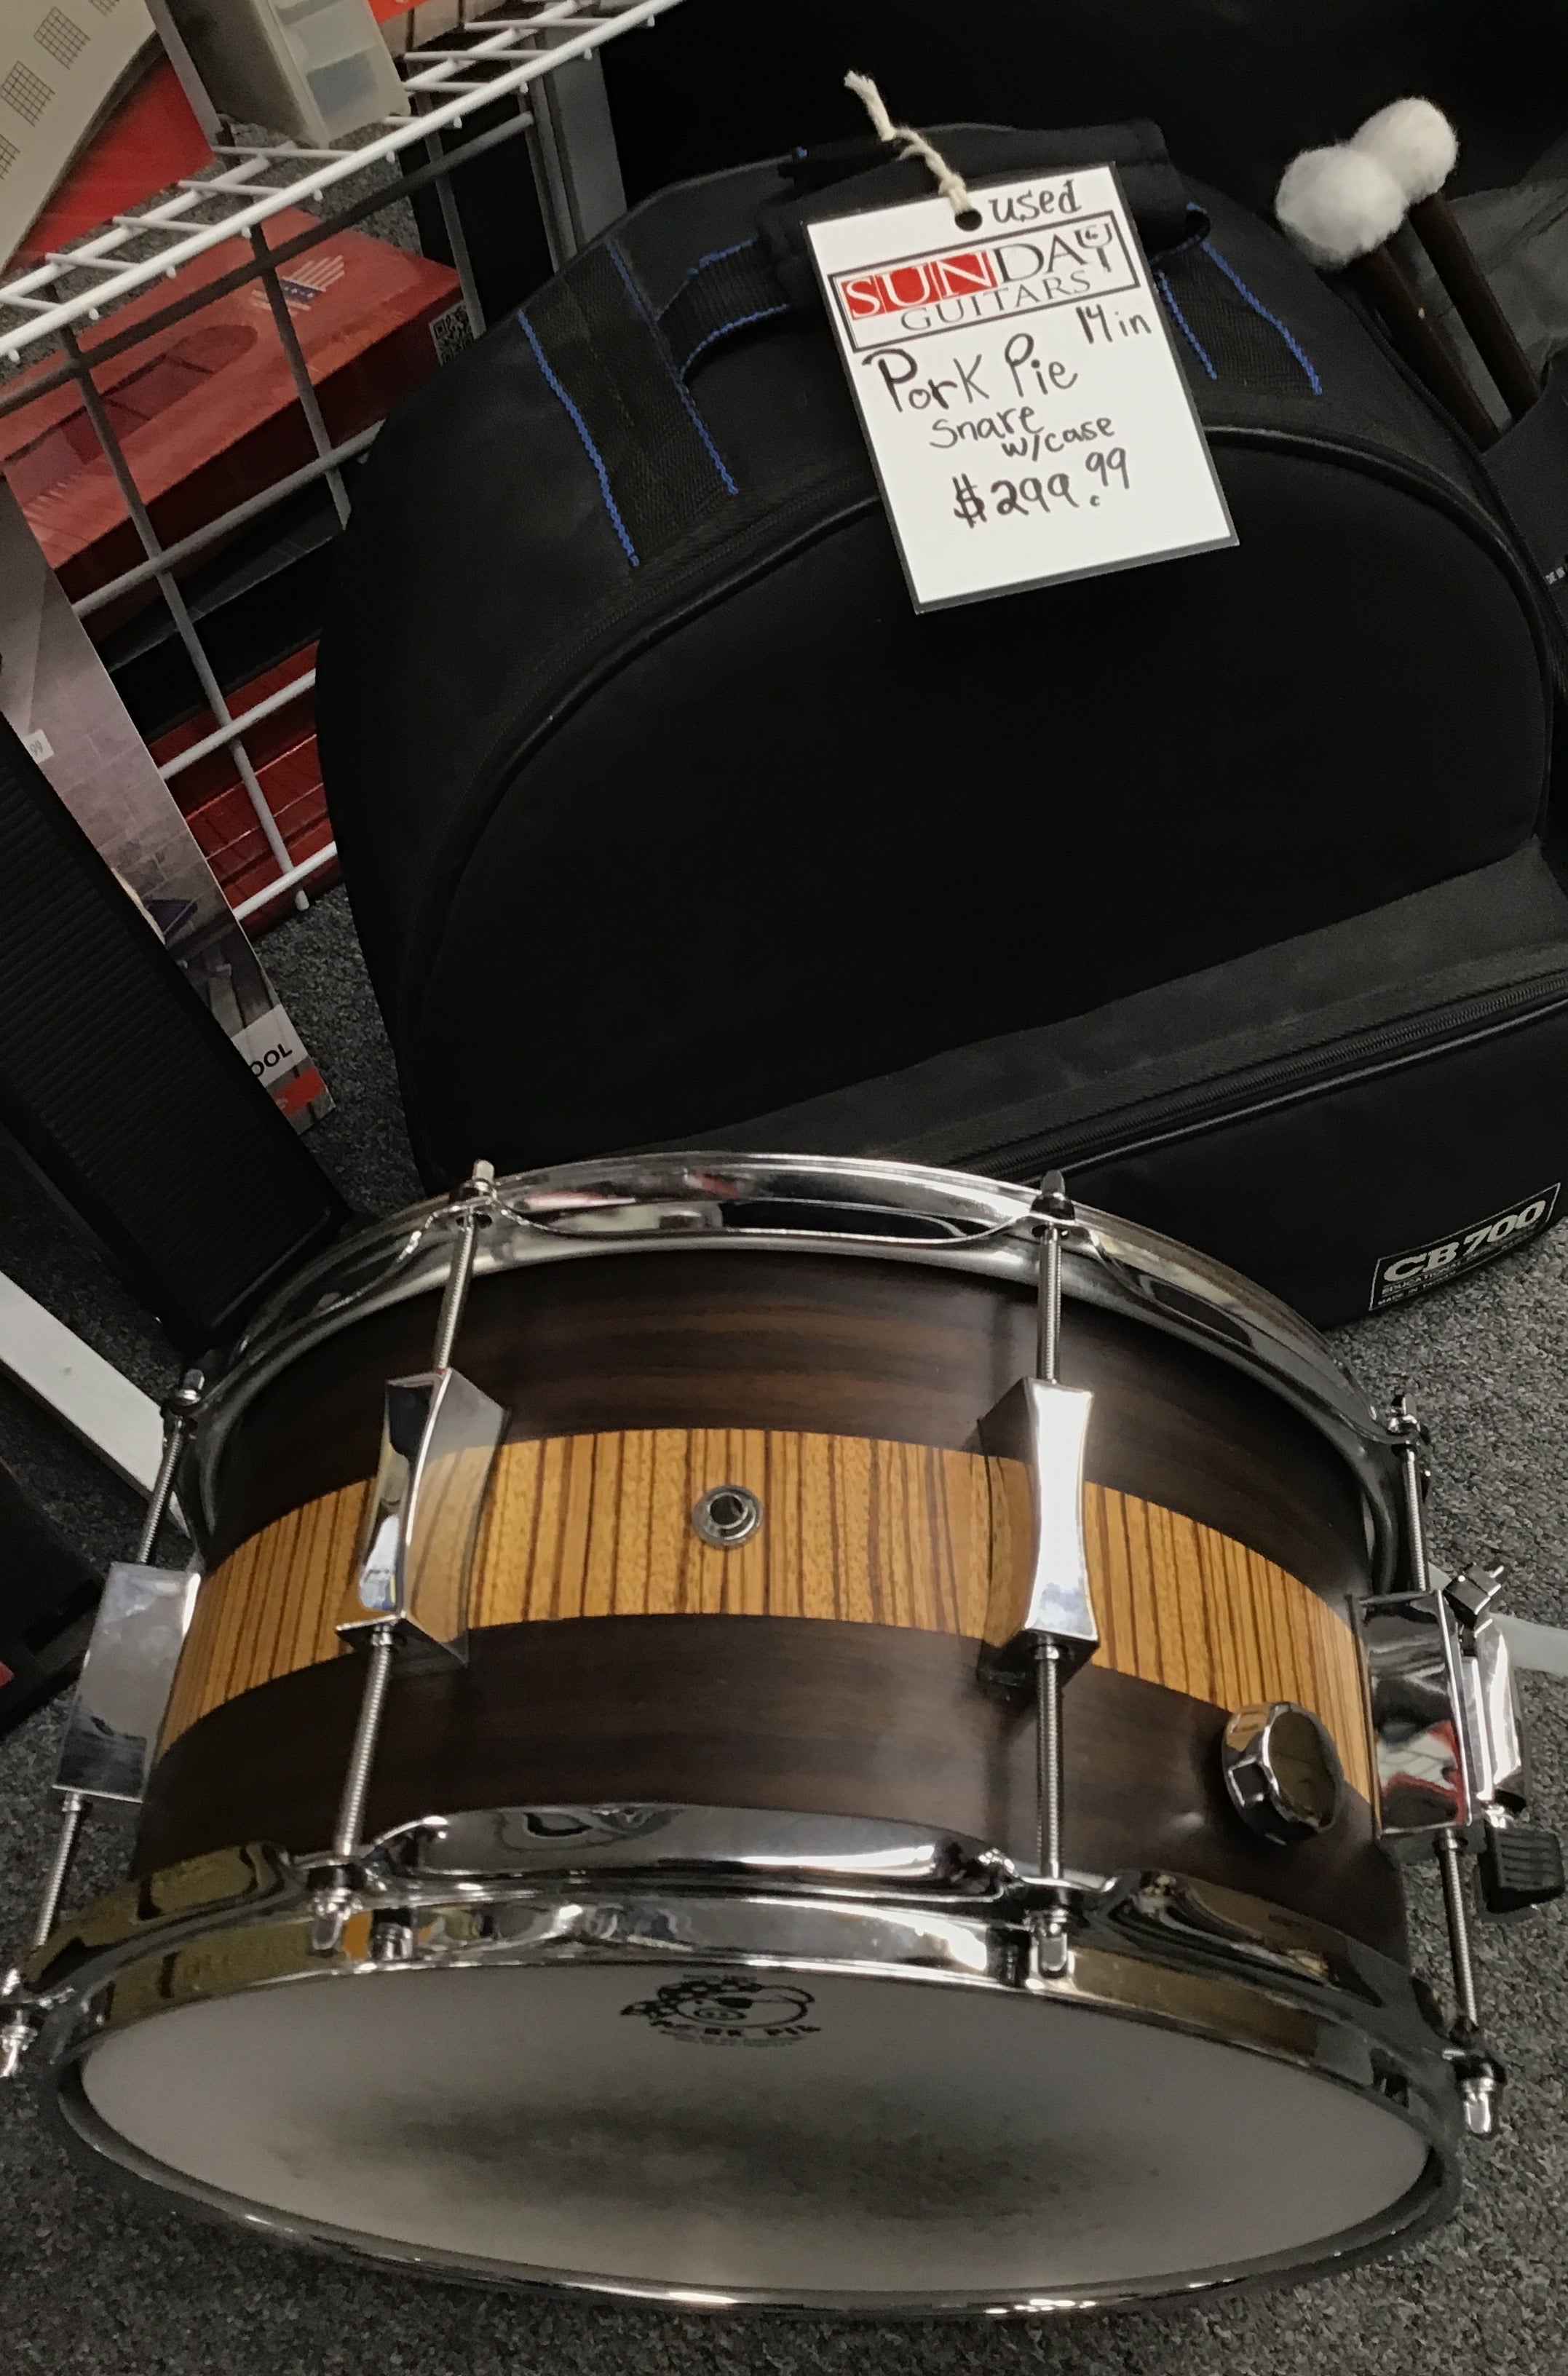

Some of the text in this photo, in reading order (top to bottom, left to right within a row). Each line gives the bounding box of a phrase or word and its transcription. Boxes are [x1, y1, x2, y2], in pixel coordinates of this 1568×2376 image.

[989, 179, 1082, 223] used
[845, 222, 1113, 320] SUNDAY
[900, 270, 1091, 331] GUITARS
[1004, 333, 1079, 398] Pie
[1001, 417, 1115, 462] w/case
